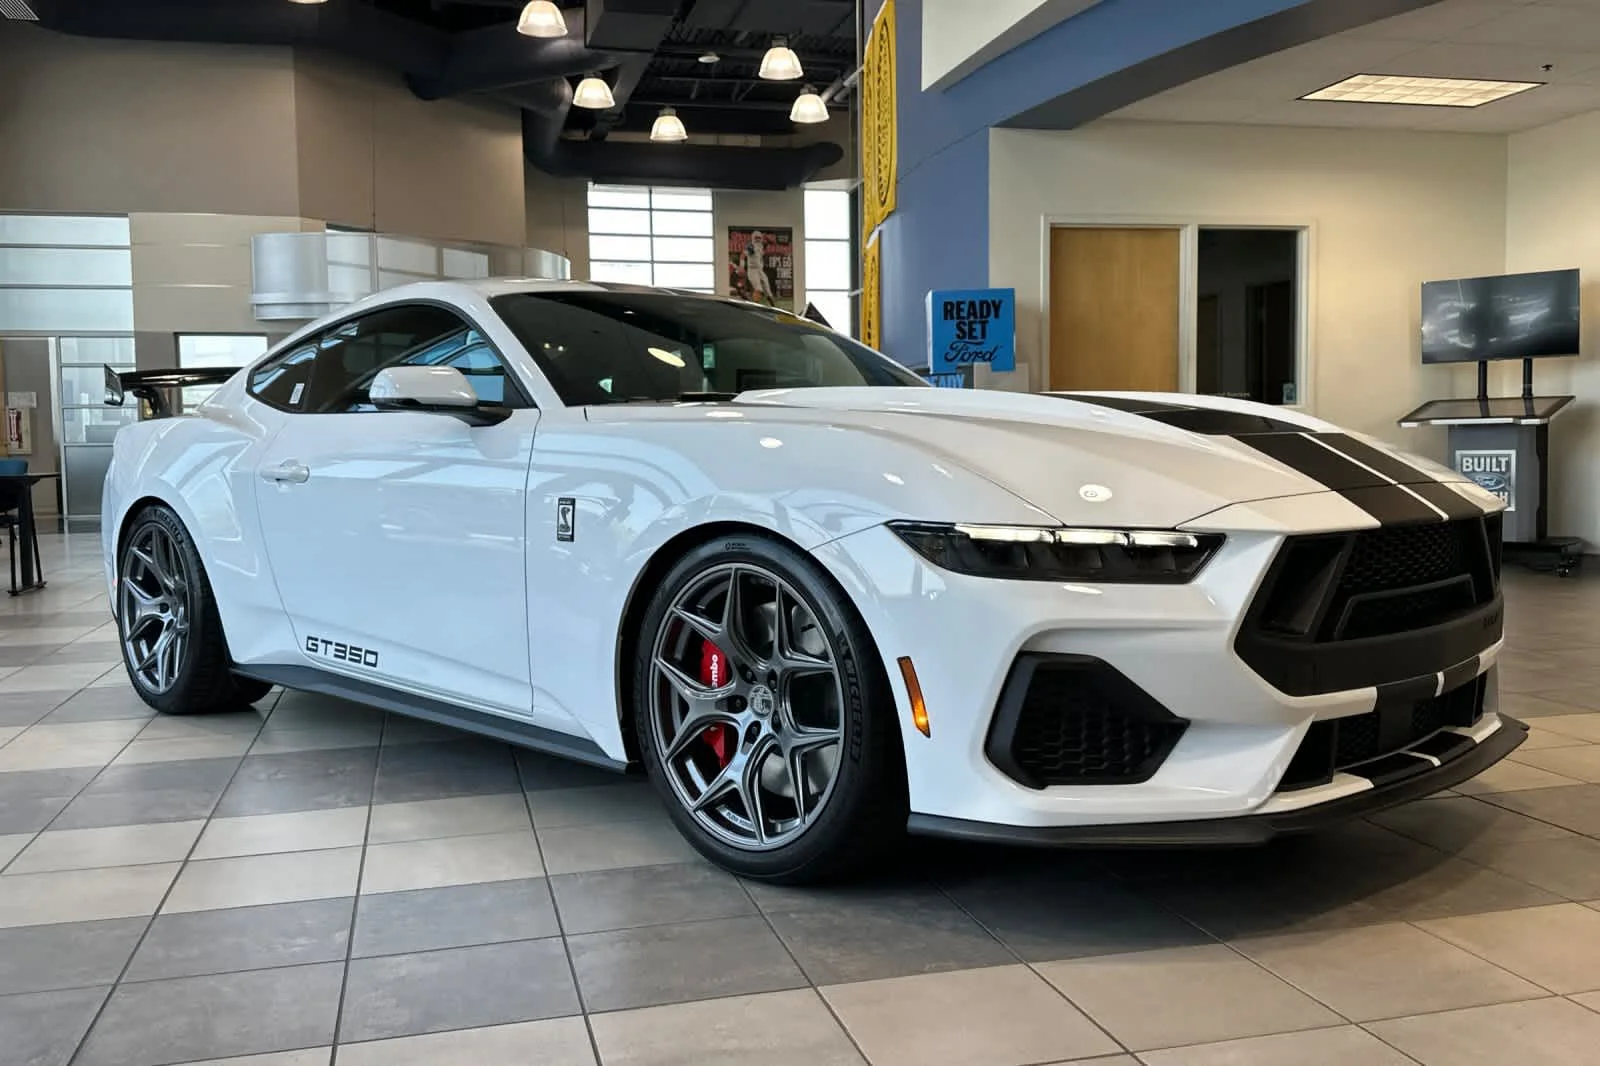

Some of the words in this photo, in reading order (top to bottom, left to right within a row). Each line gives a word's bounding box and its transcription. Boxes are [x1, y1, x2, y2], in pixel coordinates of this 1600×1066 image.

[943, 299, 1003, 321] READY
[956, 320, 989, 341] SET
[944, 341, 998, 363] Ford
[1462, 456, 1509, 473] BUILT
[305, 635, 379, 668] GT350
[709, 654, 719, 689] embo
